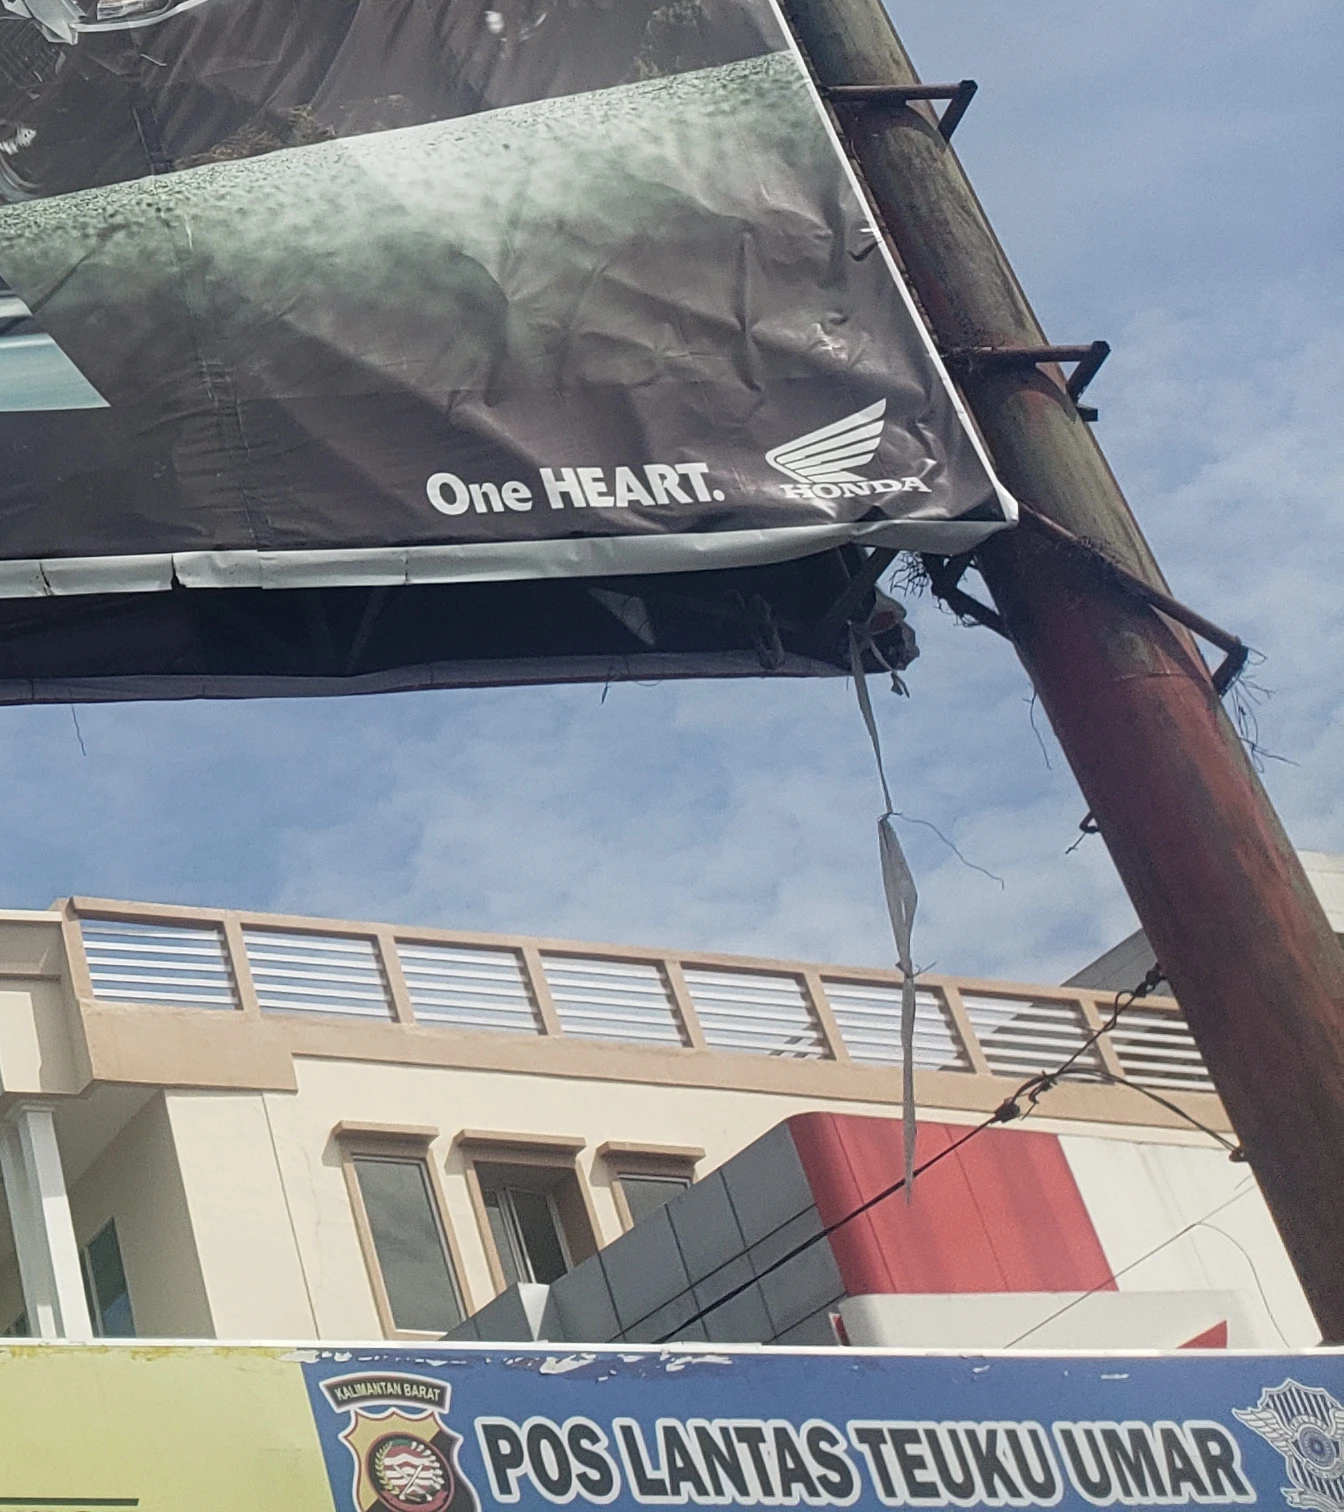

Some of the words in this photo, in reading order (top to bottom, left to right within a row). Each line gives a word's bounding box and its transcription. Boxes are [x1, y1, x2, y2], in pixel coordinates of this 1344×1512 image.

[426, 473, 533, 515] One
[539, 462, 725, 509] HEART.
[778, 476, 933, 499] HONDA
[334, 1381, 402, 1401] KALIMANTAN
[403, 1383, 441, 1402] BARAT
[481, 1423, 614, 1497] POS
[620, 1423, 854, 1500] LANTAS
[853, 1427, 1057, 1498] TEUKU
[1057, 1427, 1251, 1498] UMAR
